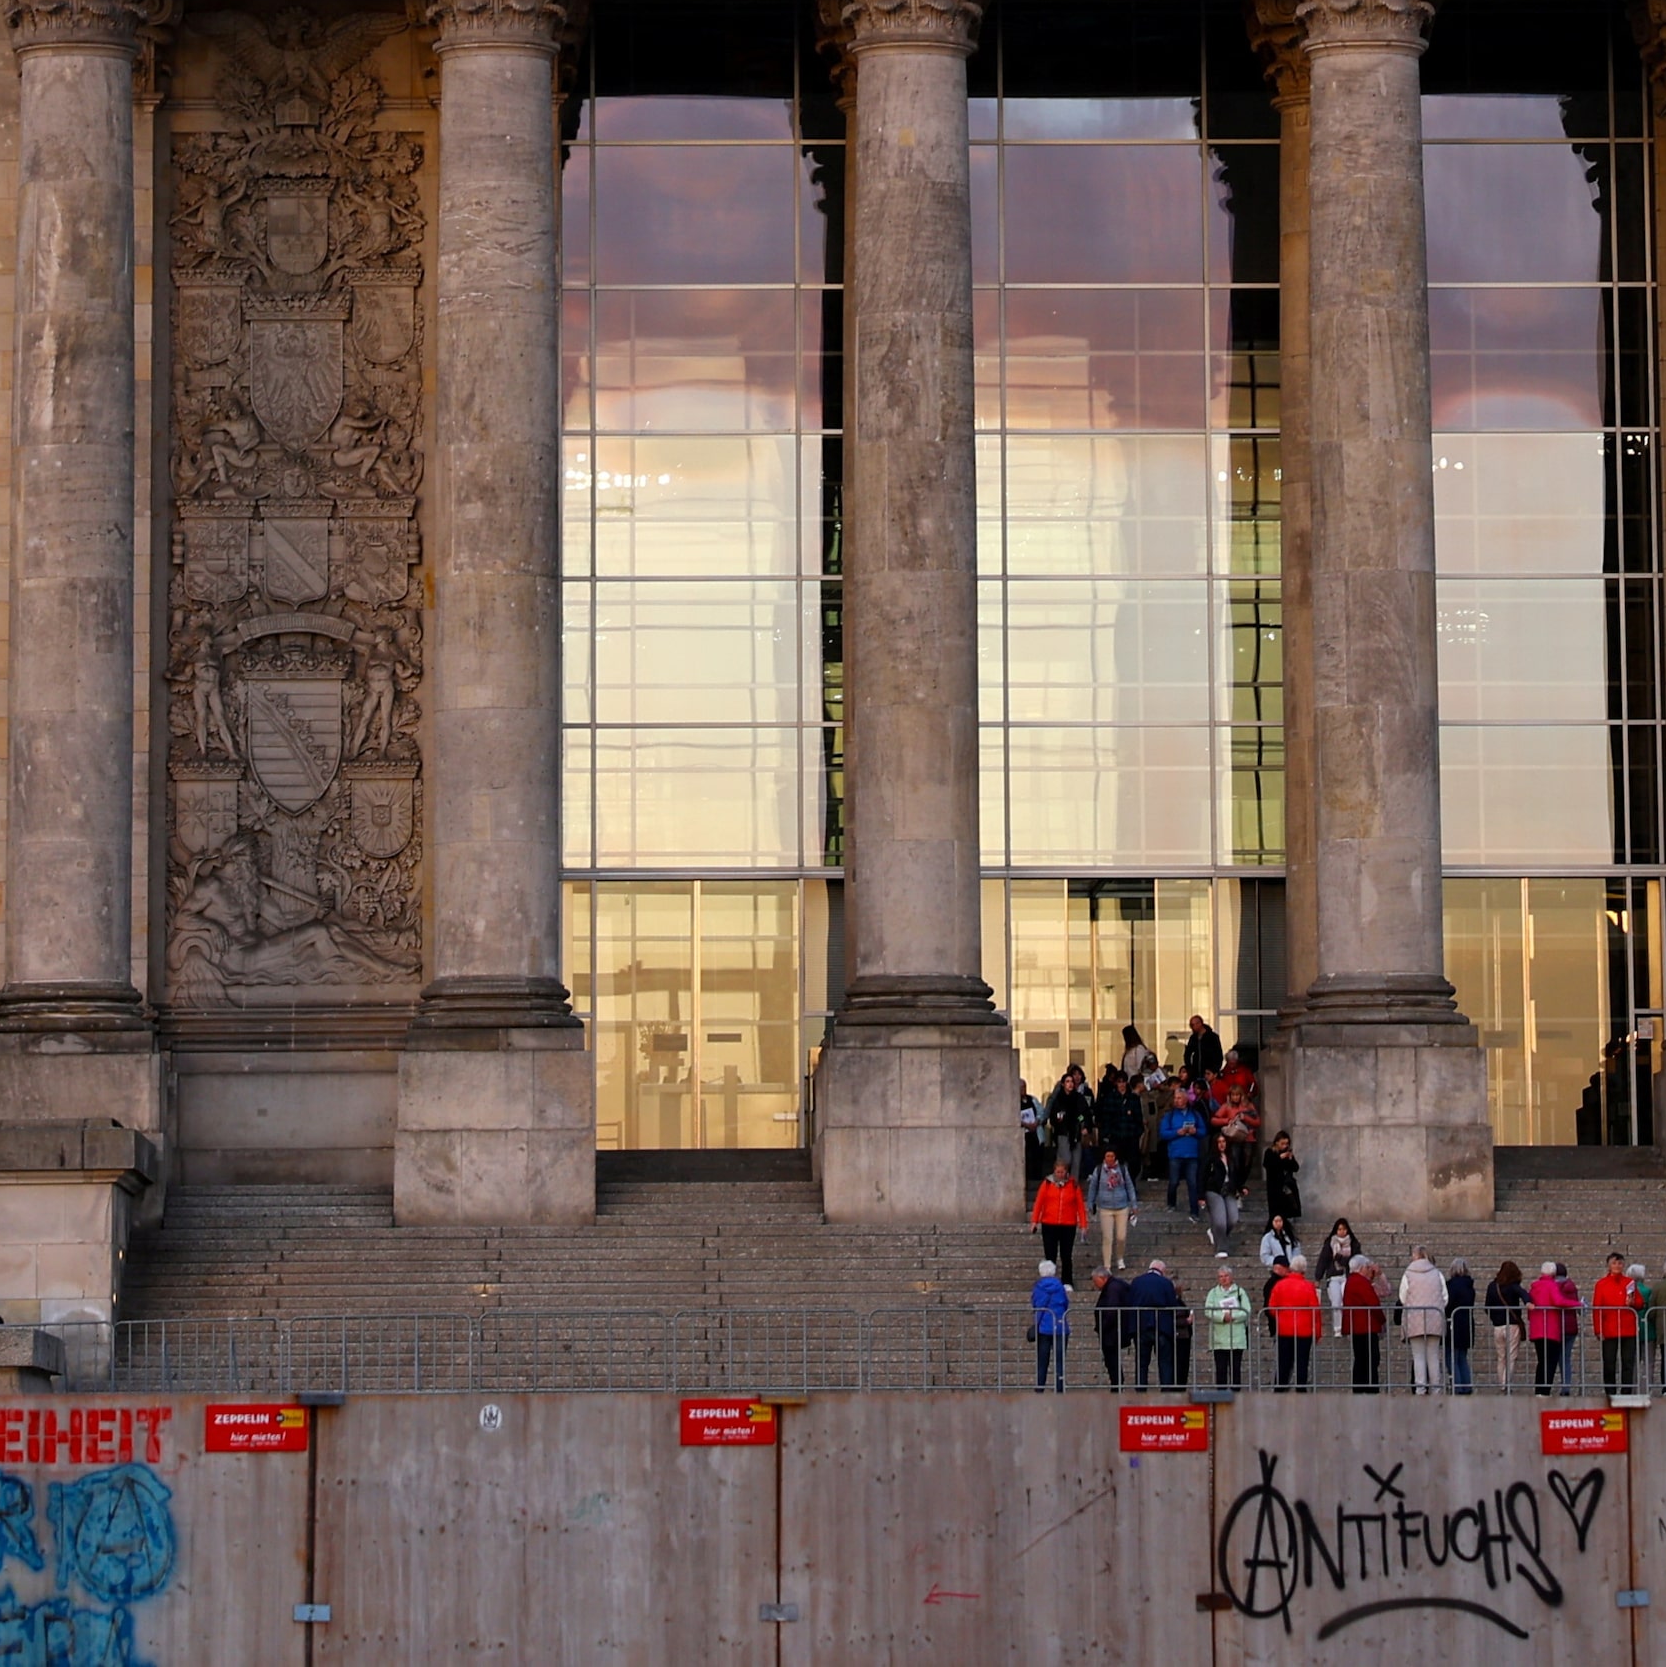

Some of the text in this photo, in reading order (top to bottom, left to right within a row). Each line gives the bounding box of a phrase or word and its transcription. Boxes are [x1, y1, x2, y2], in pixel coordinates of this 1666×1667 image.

[214, 1413, 269, 1425] ZEPPELIN
[688, 1408, 740, 1419] ZEPPELIN
[1127, 1415, 1175, 1426] ZEPPELIN
[1548, 1418, 1595, 1429] ZEPPELIN
